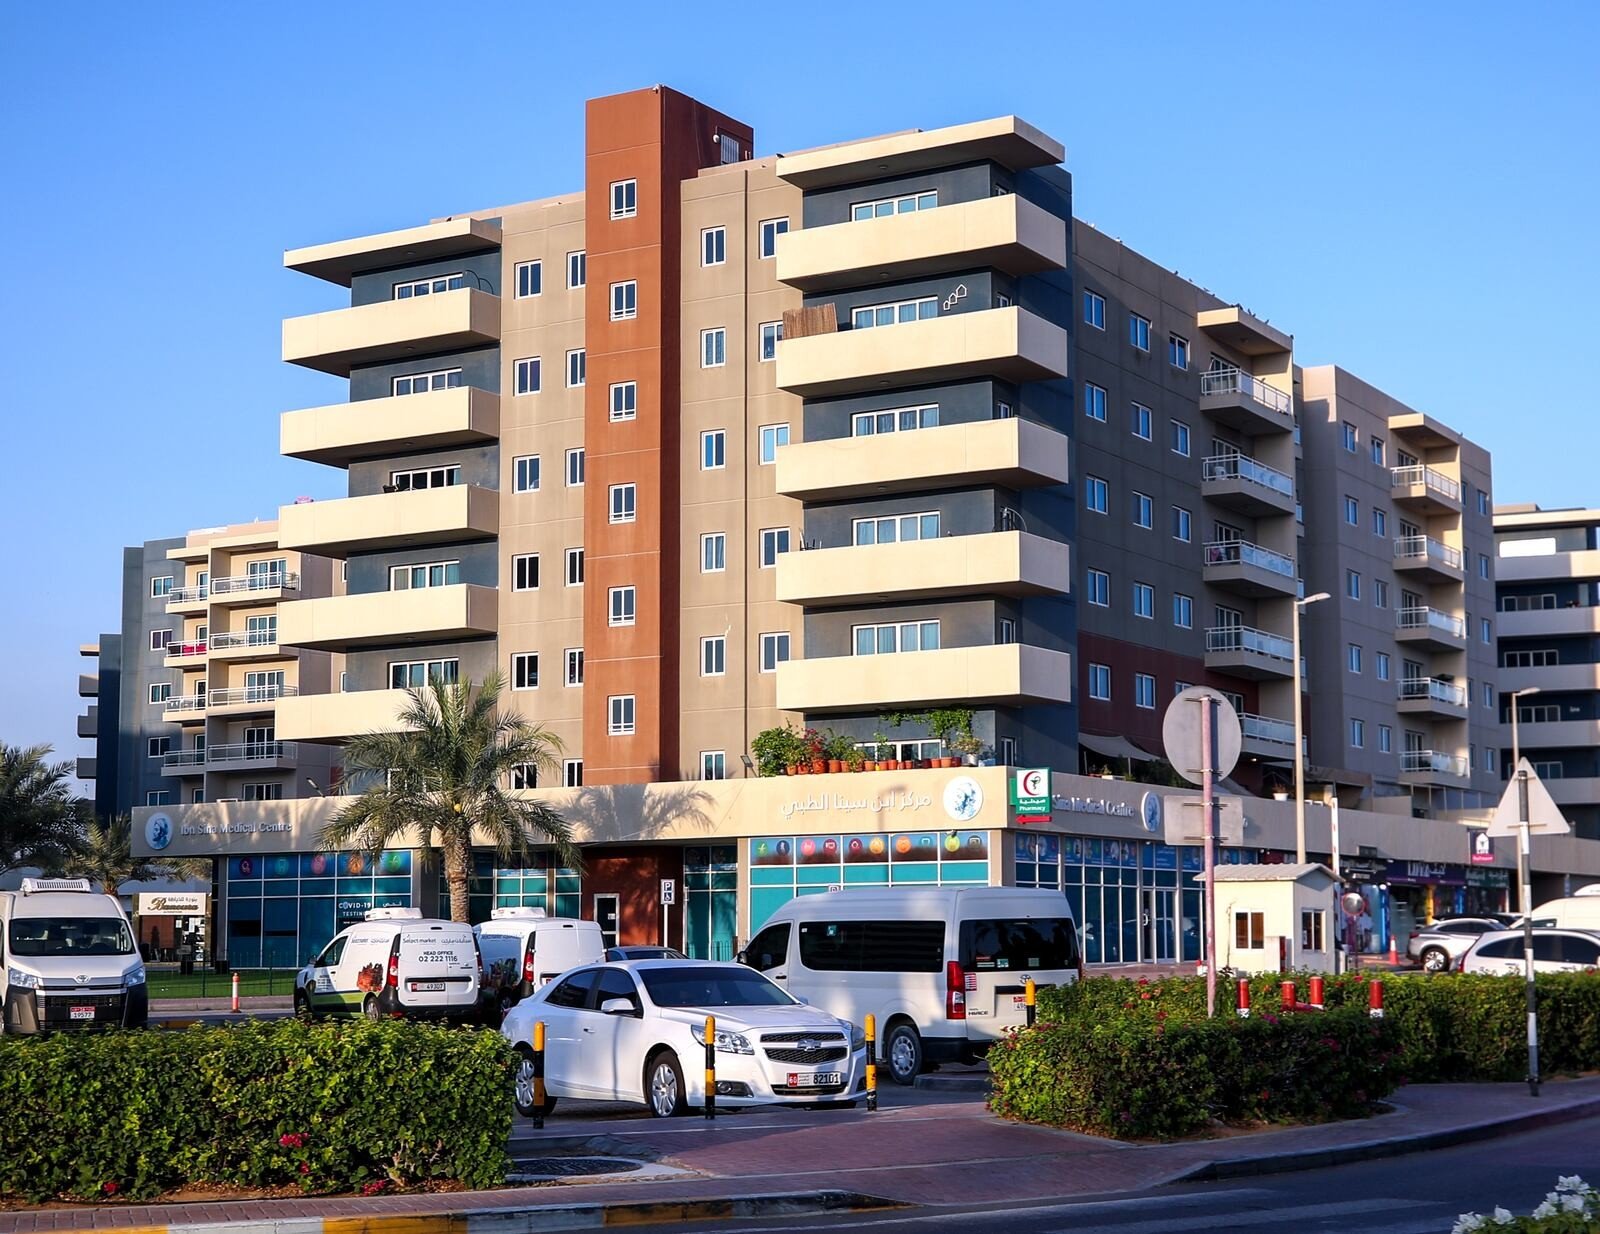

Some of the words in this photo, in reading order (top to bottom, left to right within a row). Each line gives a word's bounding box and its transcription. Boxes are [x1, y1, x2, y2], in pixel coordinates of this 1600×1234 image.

[781, 794, 830, 819] الطبي
[833, 793, 867, 813] سينا
[870, 791, 895, 813] ابن
[899, 791, 932, 811] مركز
[180, 824, 196, 836] Ibn
[198, 822, 216, 836] Sina
[219, 822, 256, 834] Medical
[258, 821, 293, 833] Centre
[338, 902, 372, 910] COVID-19
[813, 1073, 840, 1085] 82101
